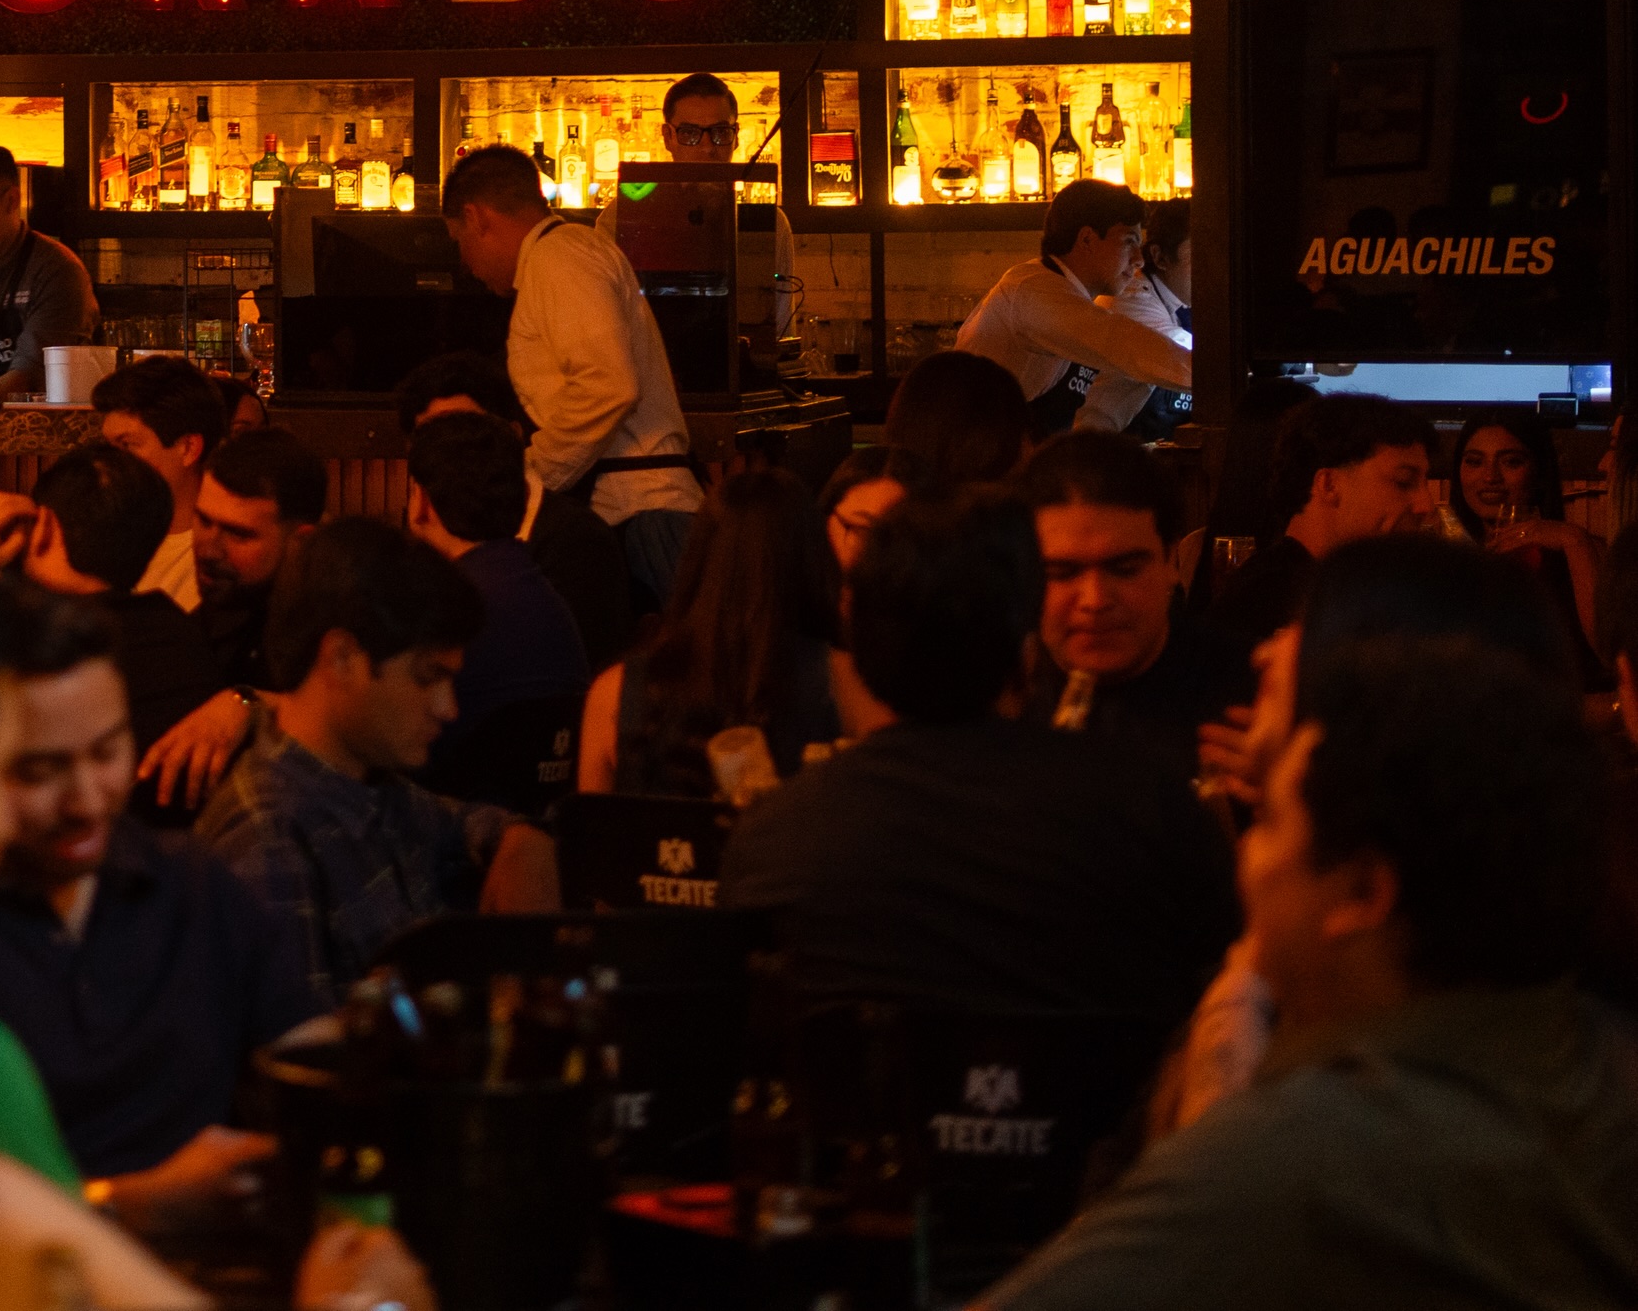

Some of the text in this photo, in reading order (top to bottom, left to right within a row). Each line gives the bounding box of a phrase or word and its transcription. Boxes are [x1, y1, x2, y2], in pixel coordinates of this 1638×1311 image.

[836, 170, 852, 183] 70
[1298, 237, 1556, 275] AGUACHILES
[1078, 366, 1097, 382] BOT
[639, 874, 717, 907] TECATE
[930, 1113, 1056, 1156] TECATE
